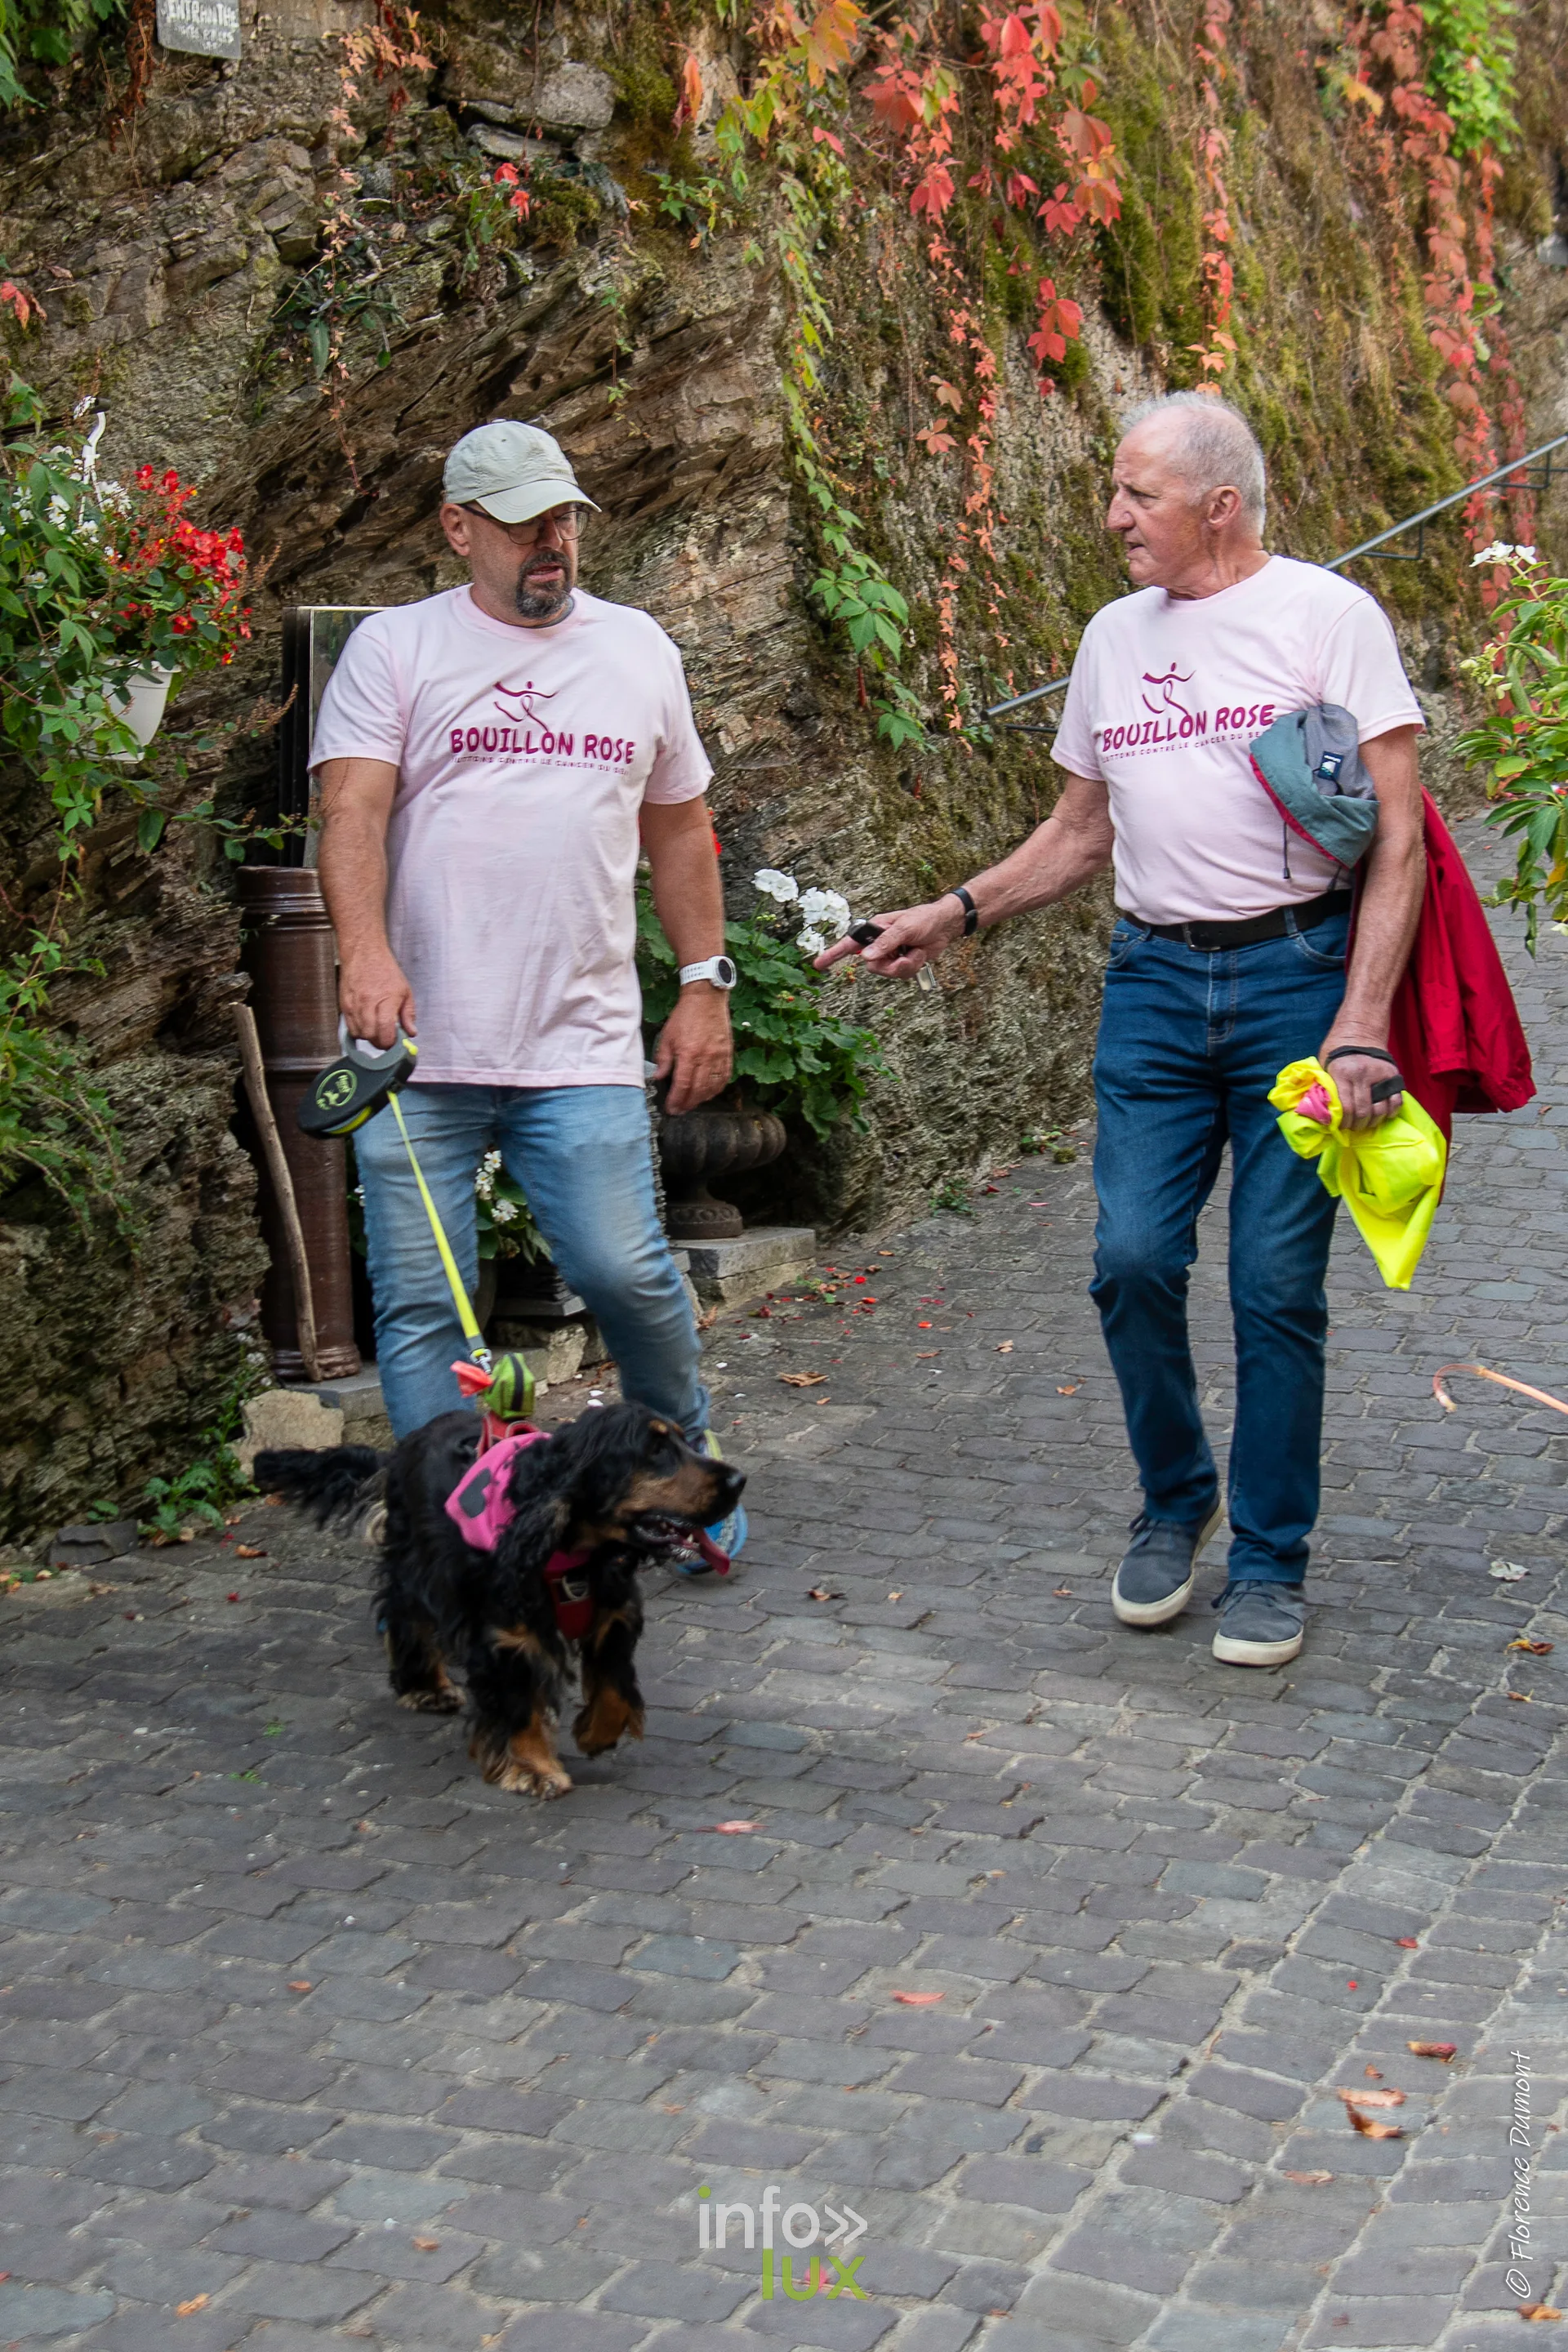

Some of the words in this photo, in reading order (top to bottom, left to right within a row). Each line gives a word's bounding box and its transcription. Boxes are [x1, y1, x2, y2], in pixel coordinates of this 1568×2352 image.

[450, 727, 574, 756] BOUILLON
[584, 733, 636, 764] ROSE
[1102, 710, 1208, 752] BOUILLON
[1214, 704, 1276, 733] ROSE
[1140, 745, 1175, 755] CONTRE
[1195, 735, 1227, 747] CANCER
